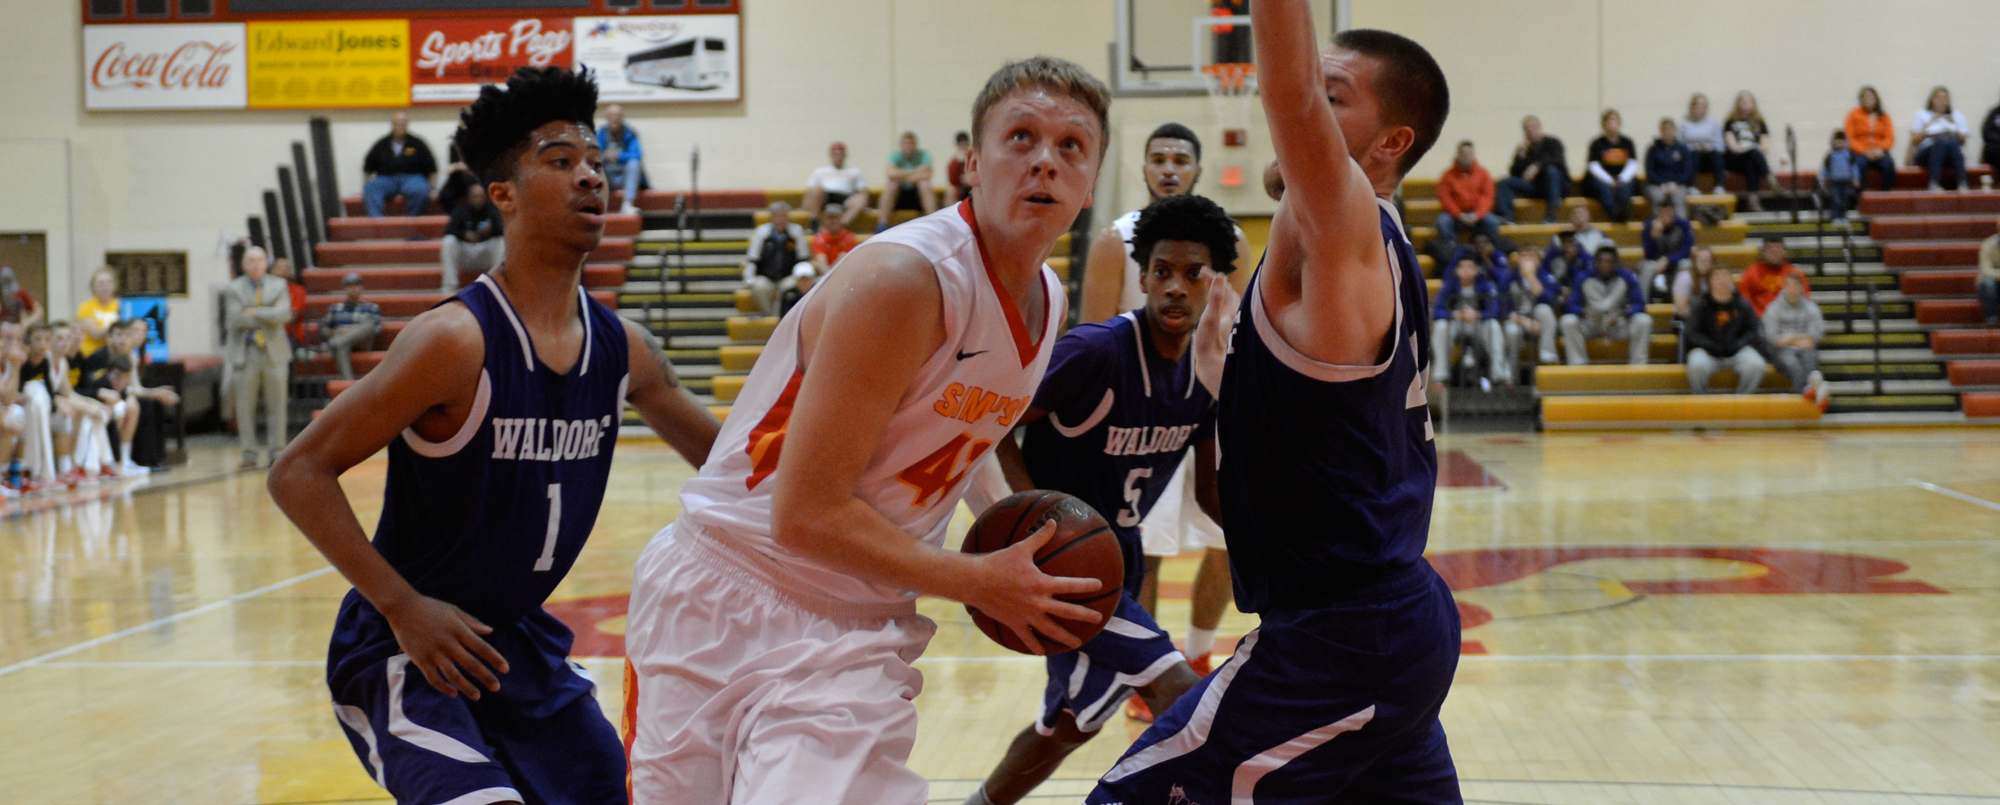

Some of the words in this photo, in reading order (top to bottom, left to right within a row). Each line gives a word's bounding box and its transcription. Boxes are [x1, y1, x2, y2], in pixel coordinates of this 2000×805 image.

[255, 28, 334, 52] Edward
[336, 29, 401, 52] Jones
[416, 30, 507, 78] Sports
[510, 18, 574, 67] Page
[491, 414, 612, 462] WALDORF
[533, 483, 561, 571] 1
[1116, 467, 1154, 527] 5
